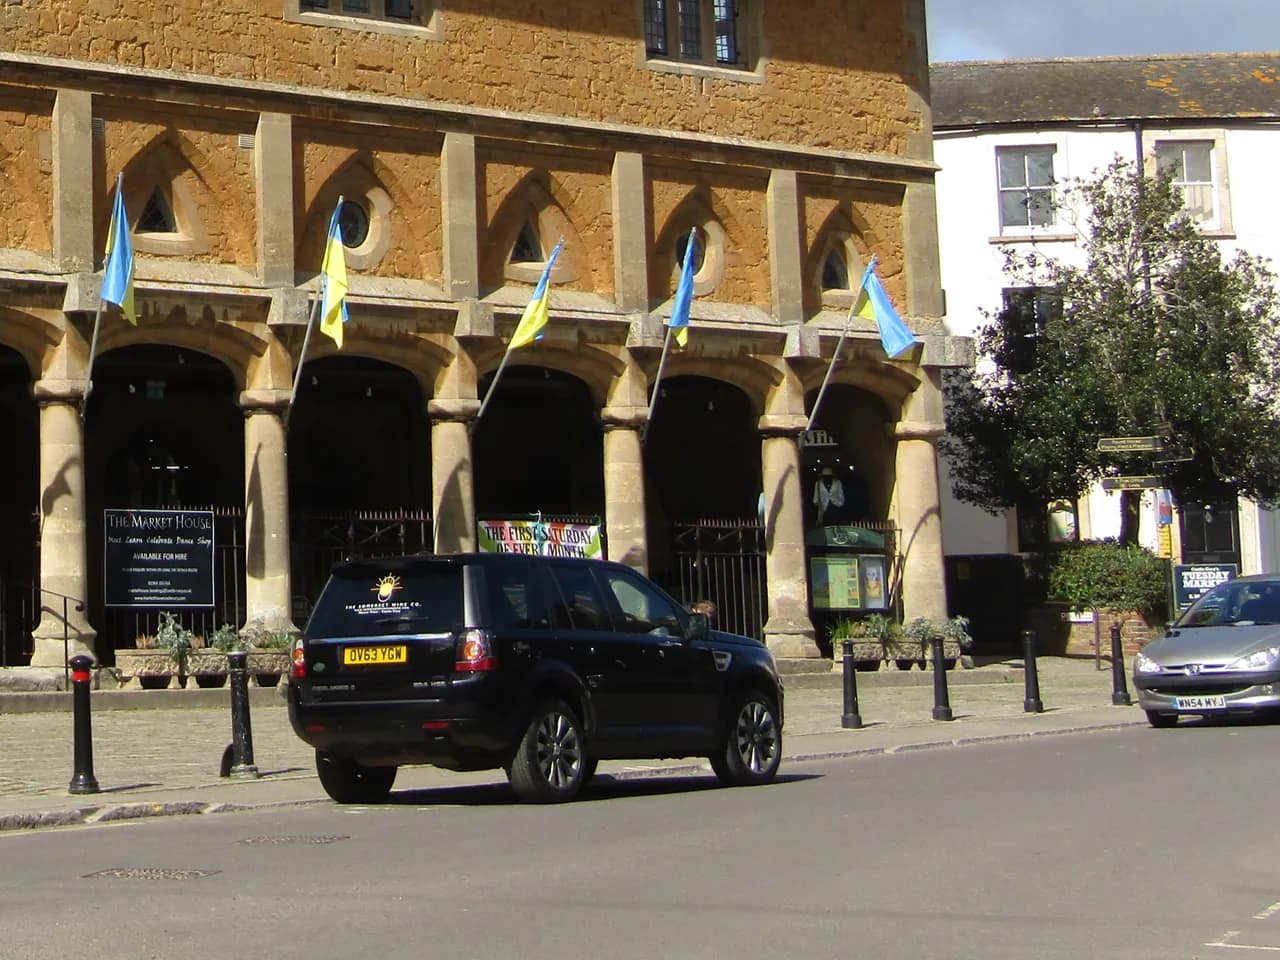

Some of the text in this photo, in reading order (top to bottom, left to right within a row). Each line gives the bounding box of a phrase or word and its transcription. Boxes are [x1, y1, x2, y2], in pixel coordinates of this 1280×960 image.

[107, 513, 211, 530] THE MARKET HOUSE
[197, 536, 212, 548] Shop
[485, 526, 593, 545] THE FIRST SATURDAY
[133, 553, 188, 561] AVAILABLE FOR HIRE
[496, 542, 510, 553] OF
[548, 544, 586, 559] MONTH
[1181, 571, 1230, 580] TUESDAY
[349, 647, 402, 662] OV63 YGW
[1179, 697, 1224, 708] WN54 MYJ
